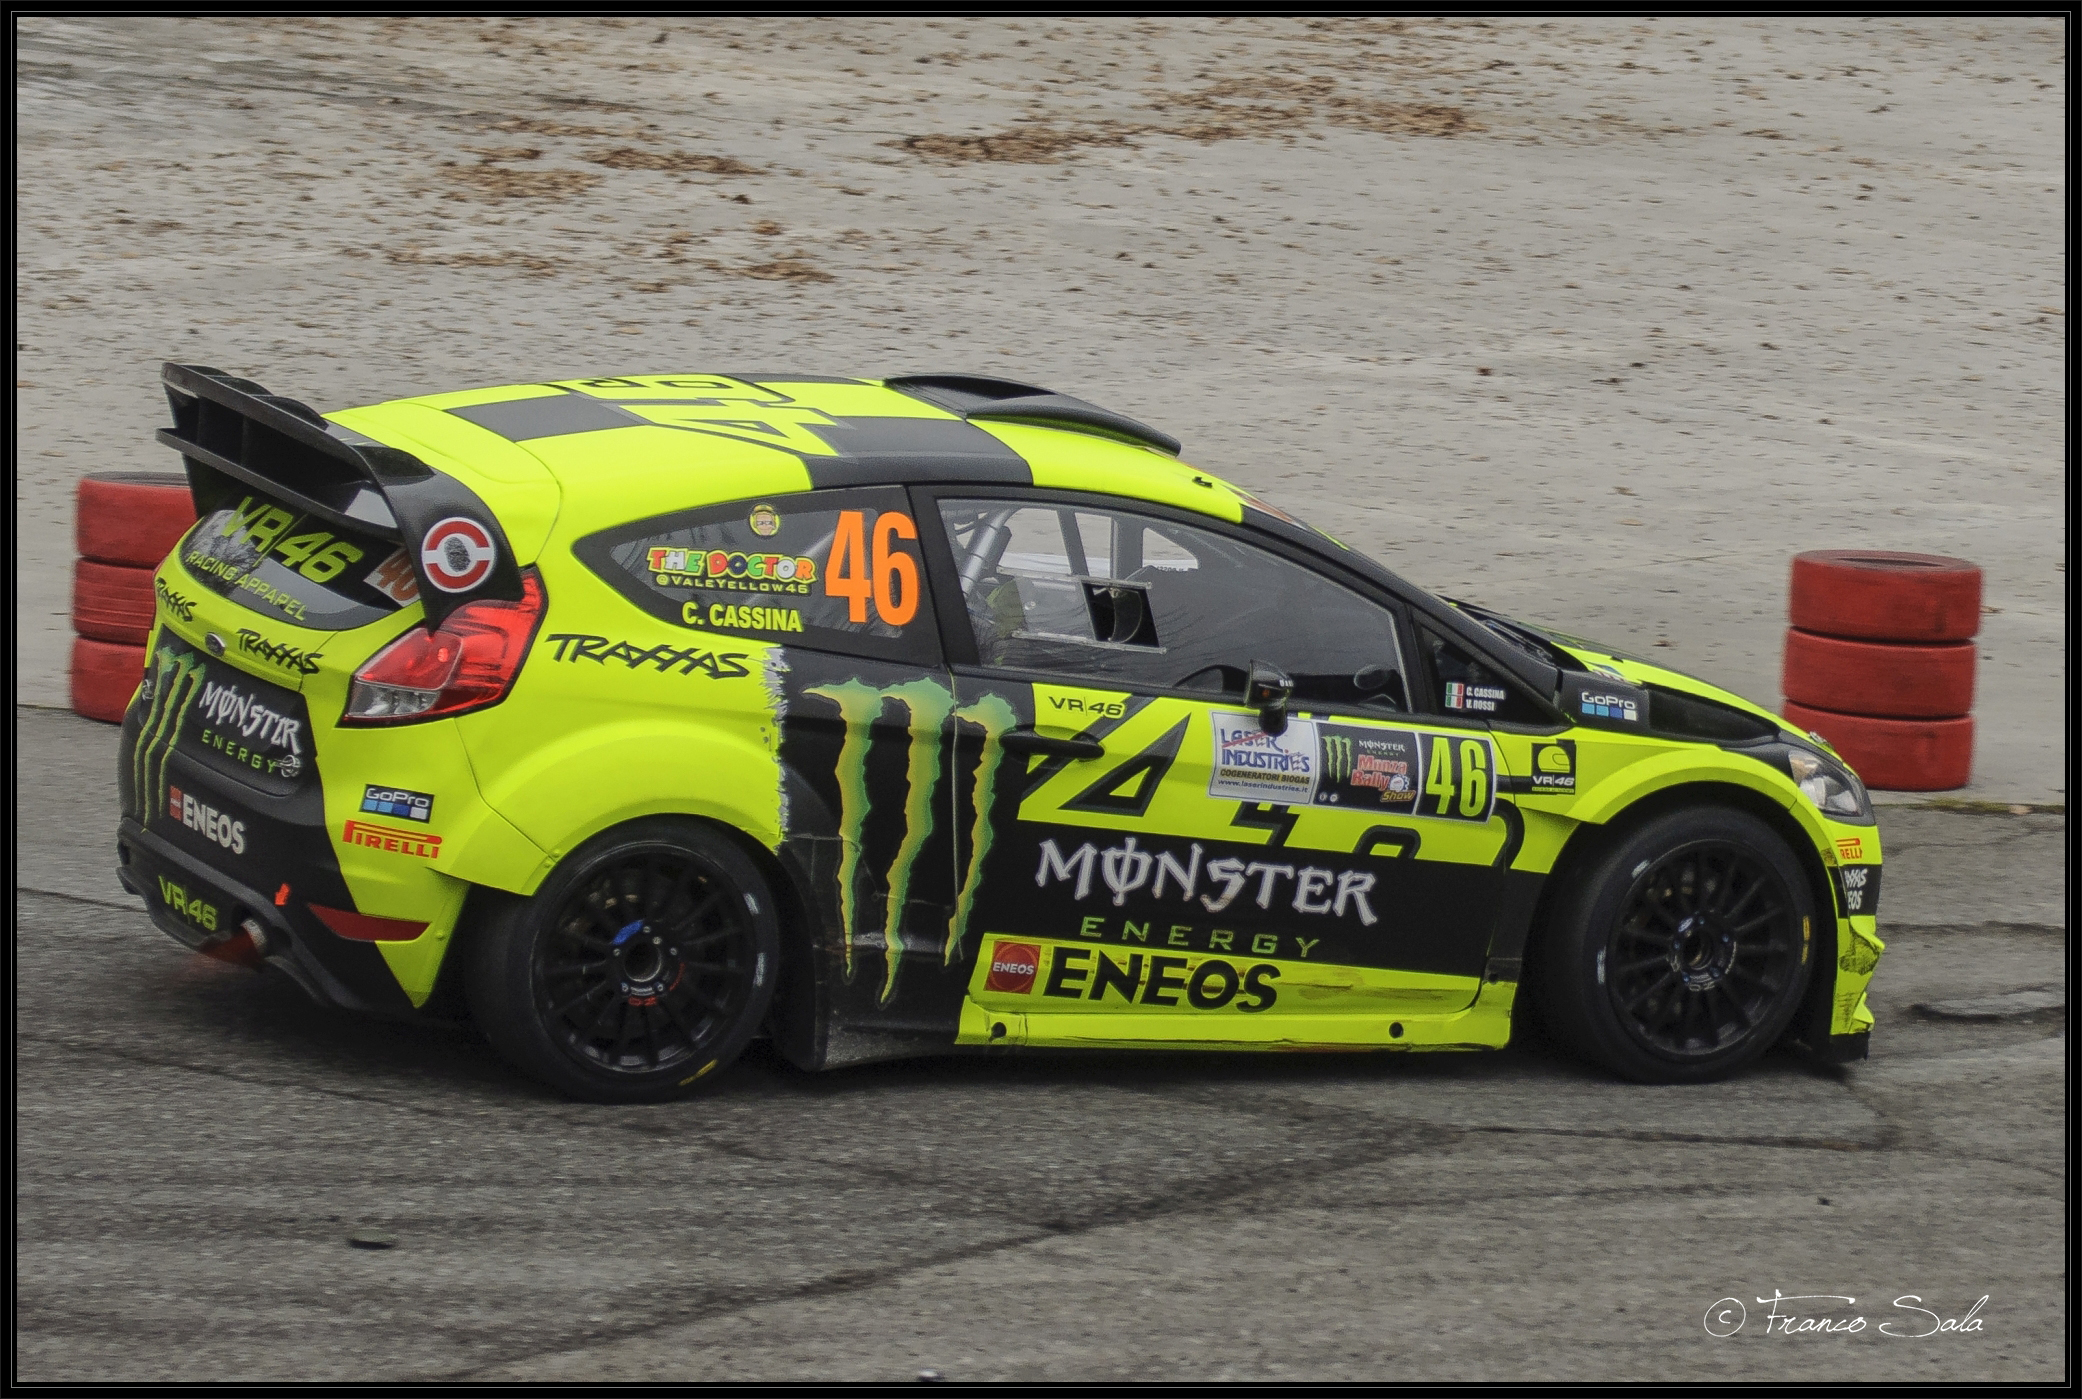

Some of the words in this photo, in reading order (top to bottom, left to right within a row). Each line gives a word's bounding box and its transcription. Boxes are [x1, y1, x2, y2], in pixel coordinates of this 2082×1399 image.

[647, 546, 707, 575] THE
[706, 550, 817, 584] DOCTOR
[823, 509, 921, 626] 46
[186, 550, 239, 580] RACING
[235, 574, 306, 622] APPAREL
[682, 601, 706, 625] C.
[709, 603, 804, 632] CASSINA
[235, 627, 324, 675] TRAXXAS
[545, 634, 750, 680] TRAXXAS
[1473, 699, 1495, 711] ROSSI
[1581, 692, 1636, 709] GoPro
[201, 728, 277, 774] ENERGY
[1218, 780, 1309, 793] www.laserindustries.it
[1220, 768, 1280, 781] COGENERATORI
[1281, 776, 1310, 785] BIOGAS
[1350, 769, 1391, 792] Rally
[1425, 736, 1487, 817] 46
[365, 788, 429, 808] GoPro
[1382, 790, 1417, 803] Show
[183, 793, 245, 855] ENEOS
[342, 819, 443, 859] PIRELLI
[1080, 916, 1320, 958] ENERGY
[993, 961, 1034, 975] ENEOS
[1043, 945, 1282, 1014] ENEOS
